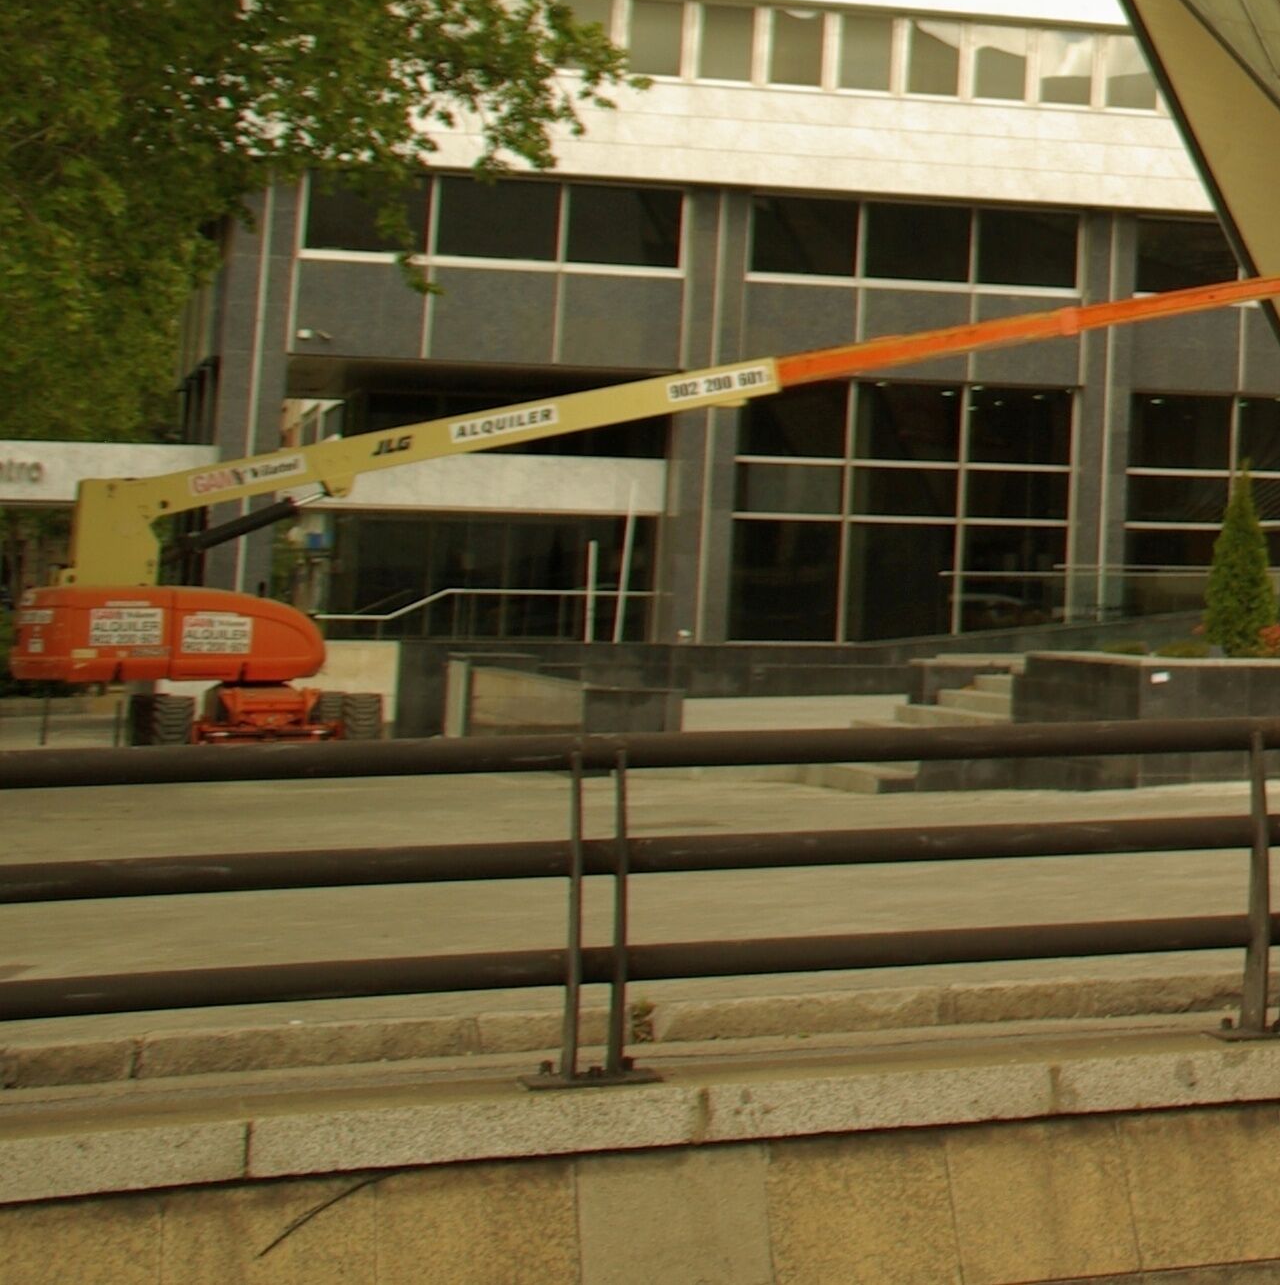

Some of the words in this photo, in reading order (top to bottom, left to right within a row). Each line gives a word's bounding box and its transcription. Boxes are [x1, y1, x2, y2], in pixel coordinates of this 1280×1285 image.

[669, 382, 698, 399] 902
[704, 375, 732, 393] 200
[736, 370, 763, 387] 601
[455, 408, 553, 439] ALQUILER
[372, 435, 412, 456] JLG
[93, 621, 160, 633] ALQUILER
[183, 629, 249, 640] ALQUILER
